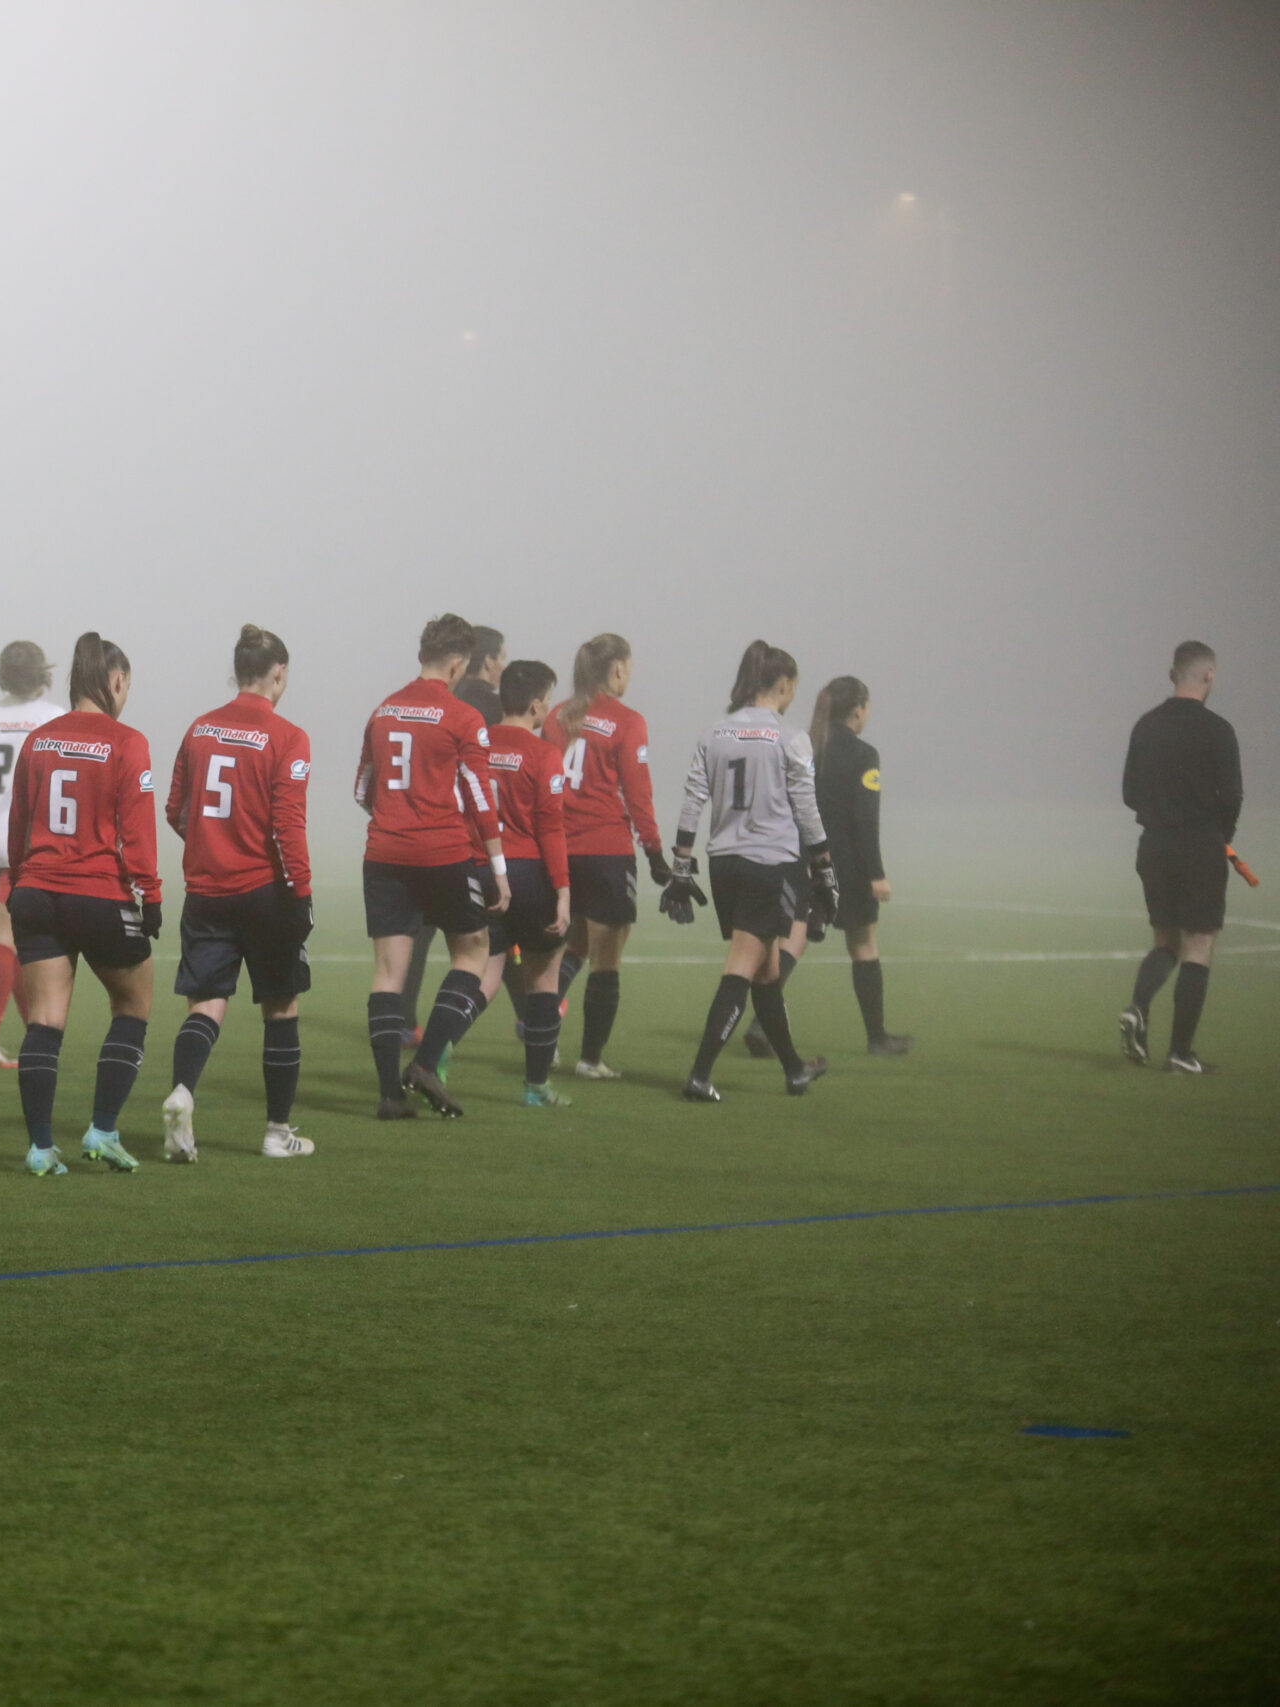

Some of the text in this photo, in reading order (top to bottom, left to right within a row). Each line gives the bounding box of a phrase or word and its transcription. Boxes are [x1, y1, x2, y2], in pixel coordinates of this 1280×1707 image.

[202, 754, 236, 819] 5
[387, 731, 413, 790] 3
[563, 737, 586, 790] 4
[727, 757, 747, 810] 1
[48, 769, 78, 836] 6
